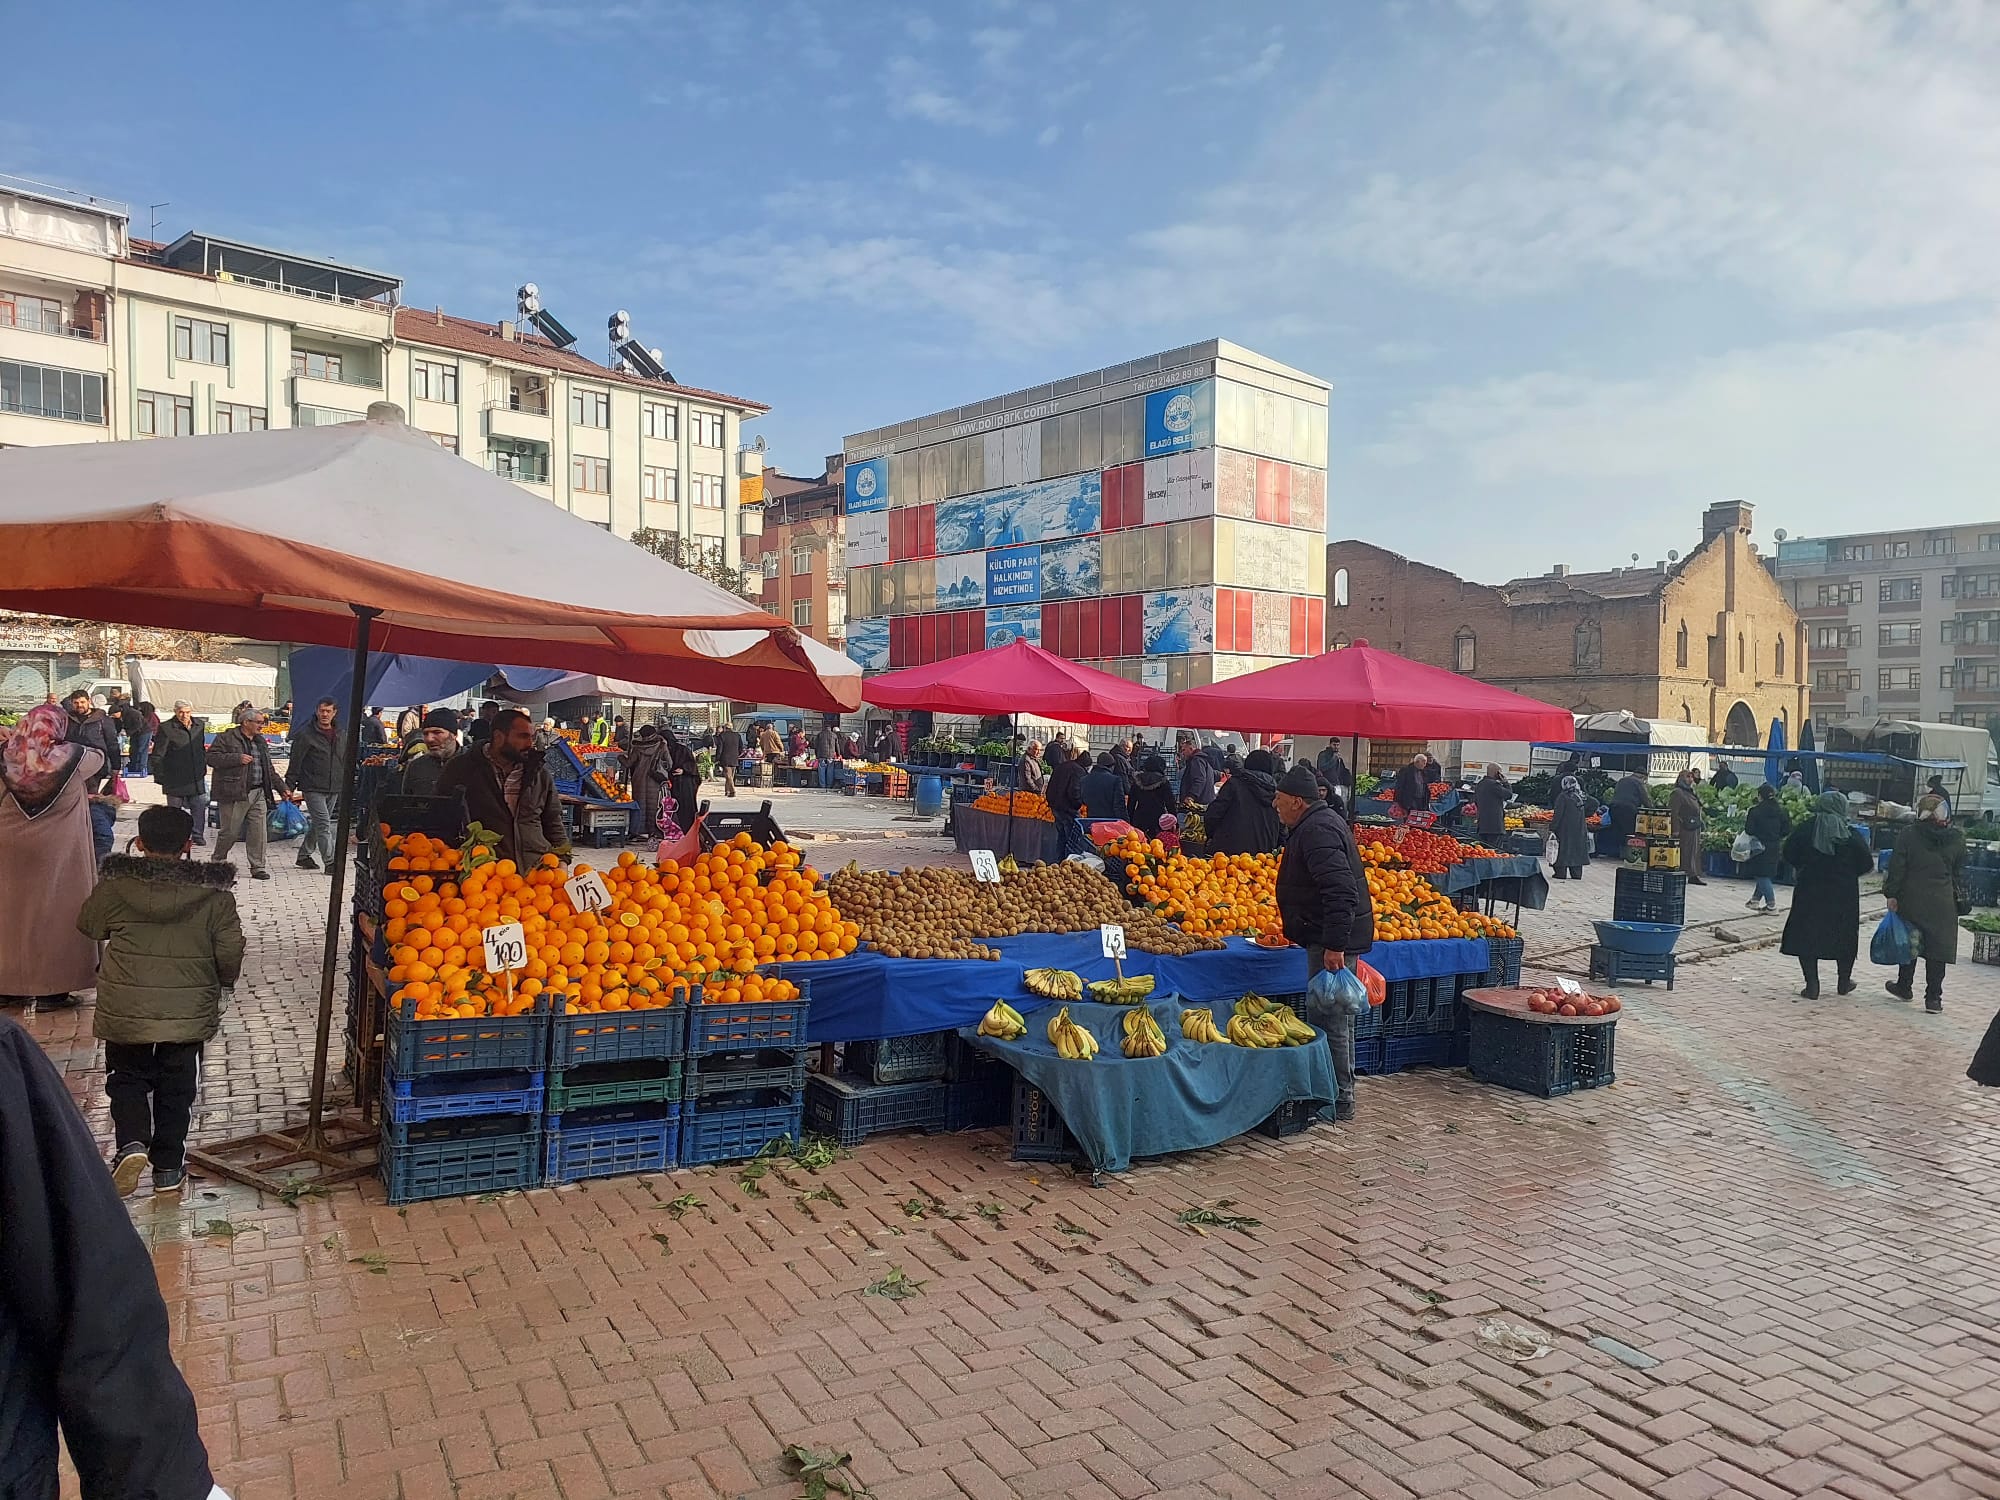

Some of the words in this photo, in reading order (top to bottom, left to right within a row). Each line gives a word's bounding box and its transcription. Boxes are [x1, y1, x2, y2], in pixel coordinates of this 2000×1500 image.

[952, 402, 1059, 436] www.polipark.com.tr
[989, 557, 1017, 570] KÜLTÜR
[1018, 556, 1038, 567] PARK
[993, 570, 1033, 583] HALKIMIZIN
[576, 881, 602, 911] 25
[485, 929, 499, 947] 4
[494, 941, 522, 966] 100
